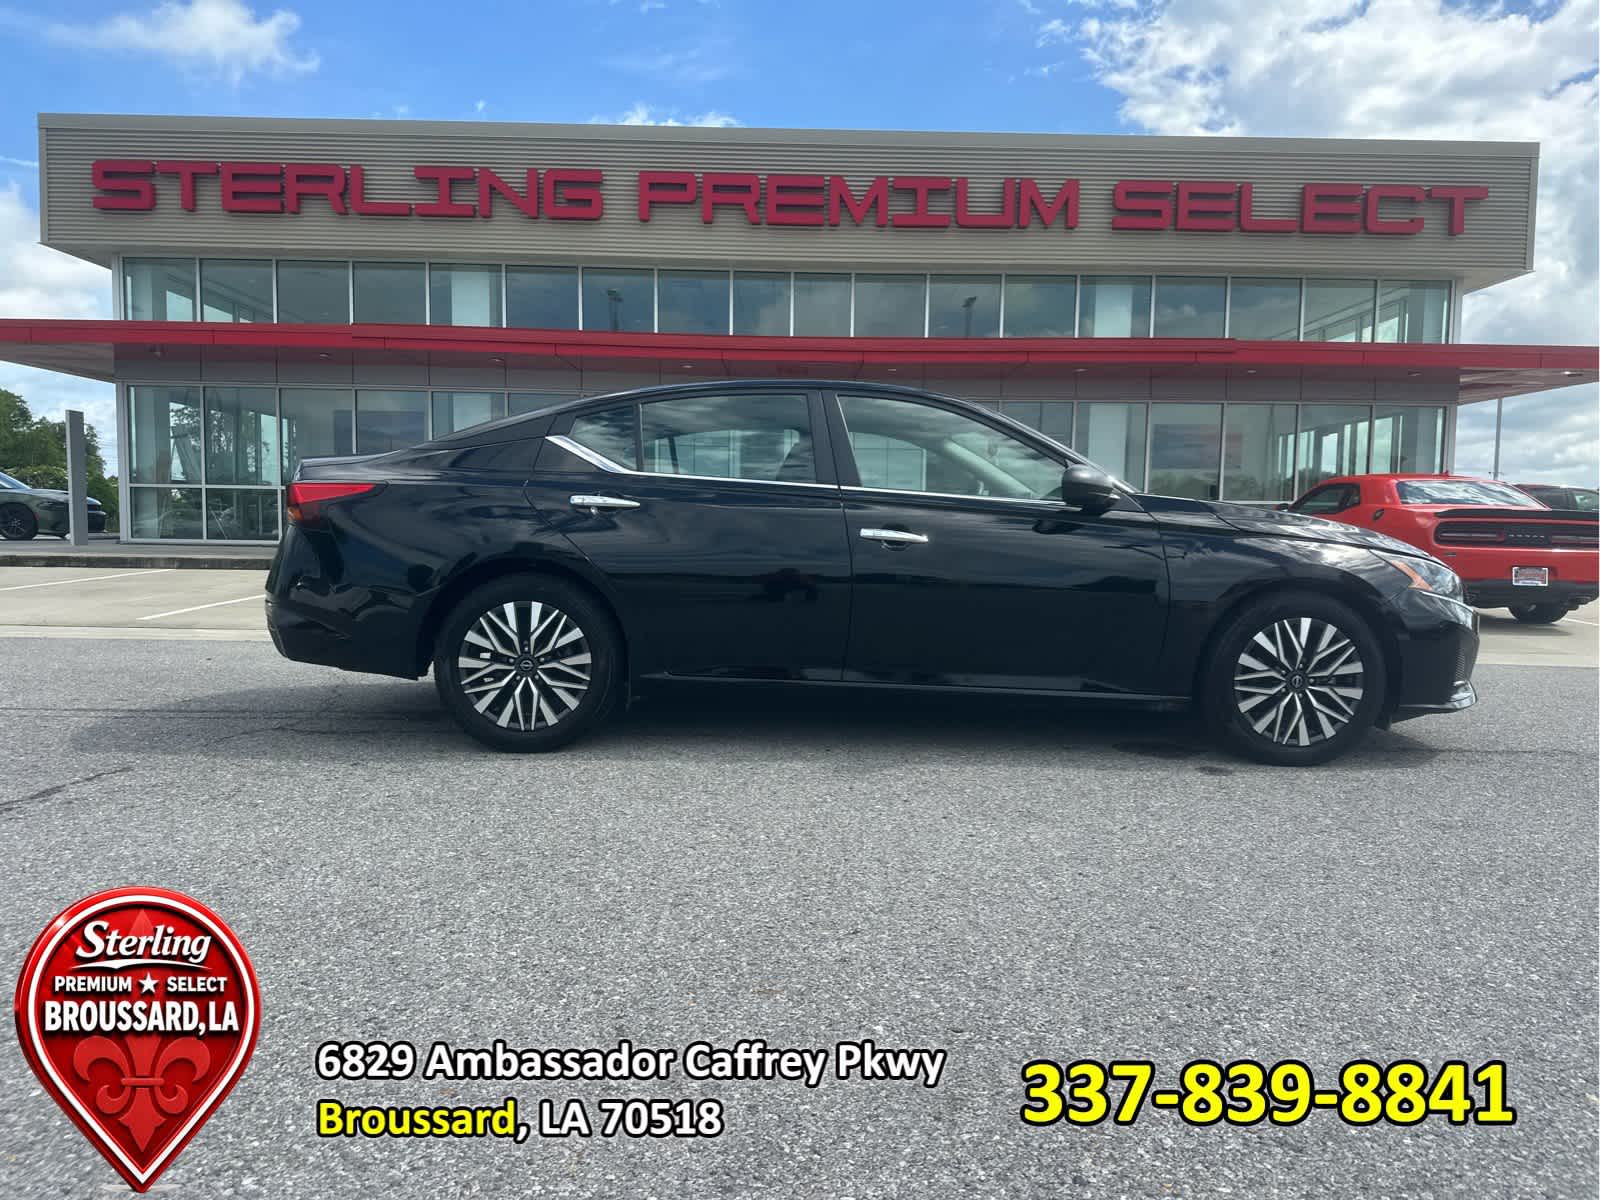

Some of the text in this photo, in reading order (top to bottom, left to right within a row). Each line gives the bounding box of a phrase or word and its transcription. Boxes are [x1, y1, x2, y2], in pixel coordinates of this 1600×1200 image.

[92, 160, 1489, 236] STERLING PREMIUM SELECT
